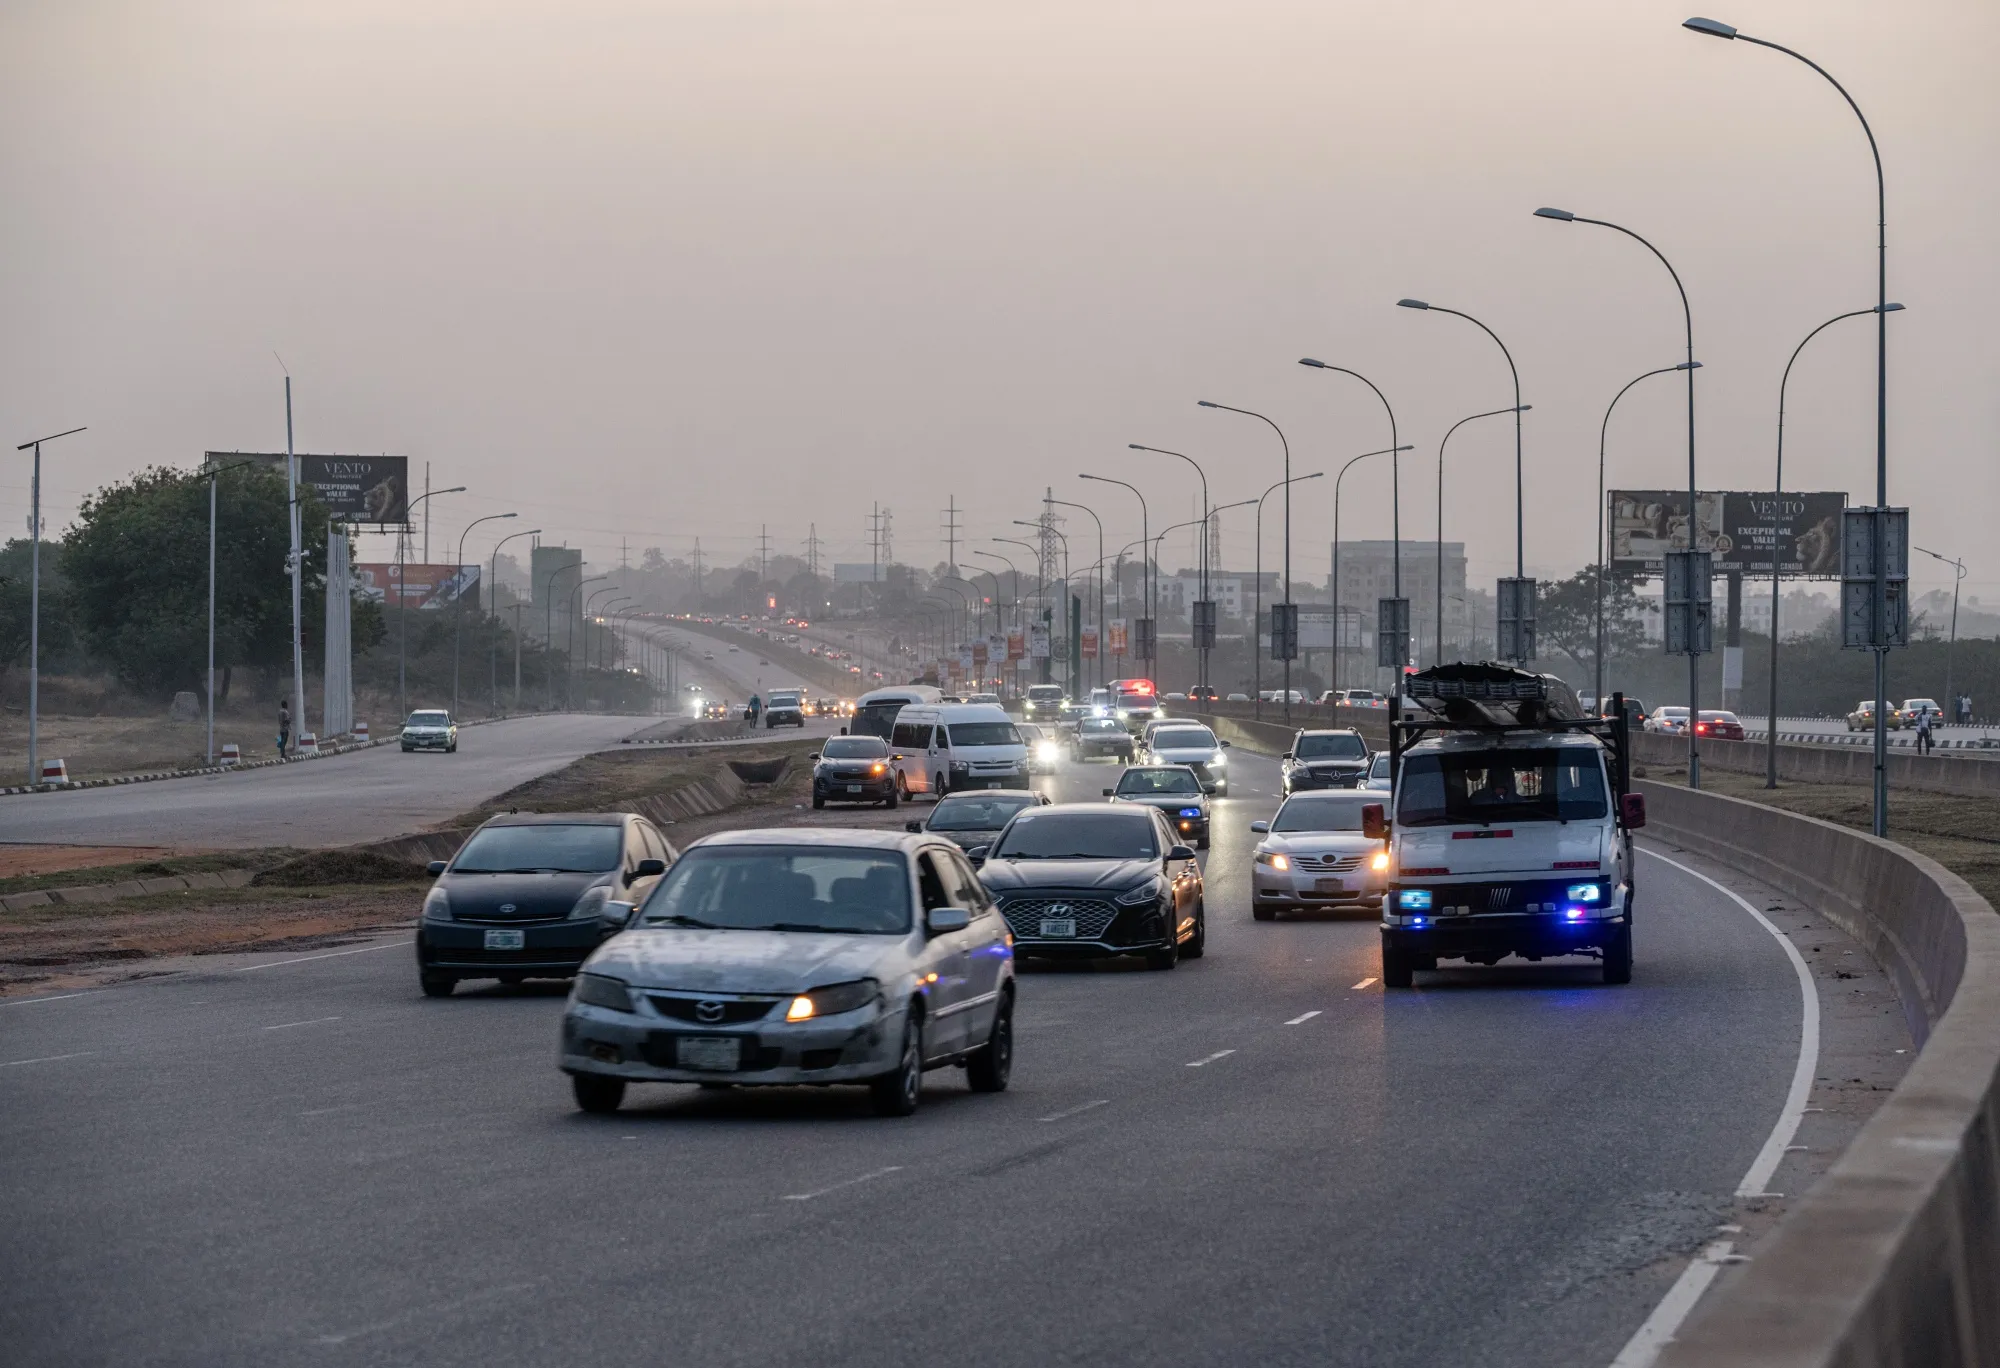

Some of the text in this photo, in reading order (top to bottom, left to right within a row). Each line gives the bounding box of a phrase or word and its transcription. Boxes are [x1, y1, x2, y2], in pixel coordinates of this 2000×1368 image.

[324, 462, 371, 473] VENTO
[1644, 561, 1664, 569] ABUJA
[1713, 561, 1743, 570] HARCOURT
[1750, 561, 1774, 570] KADUNA
[1779, 562, 1803, 570] CANADA
